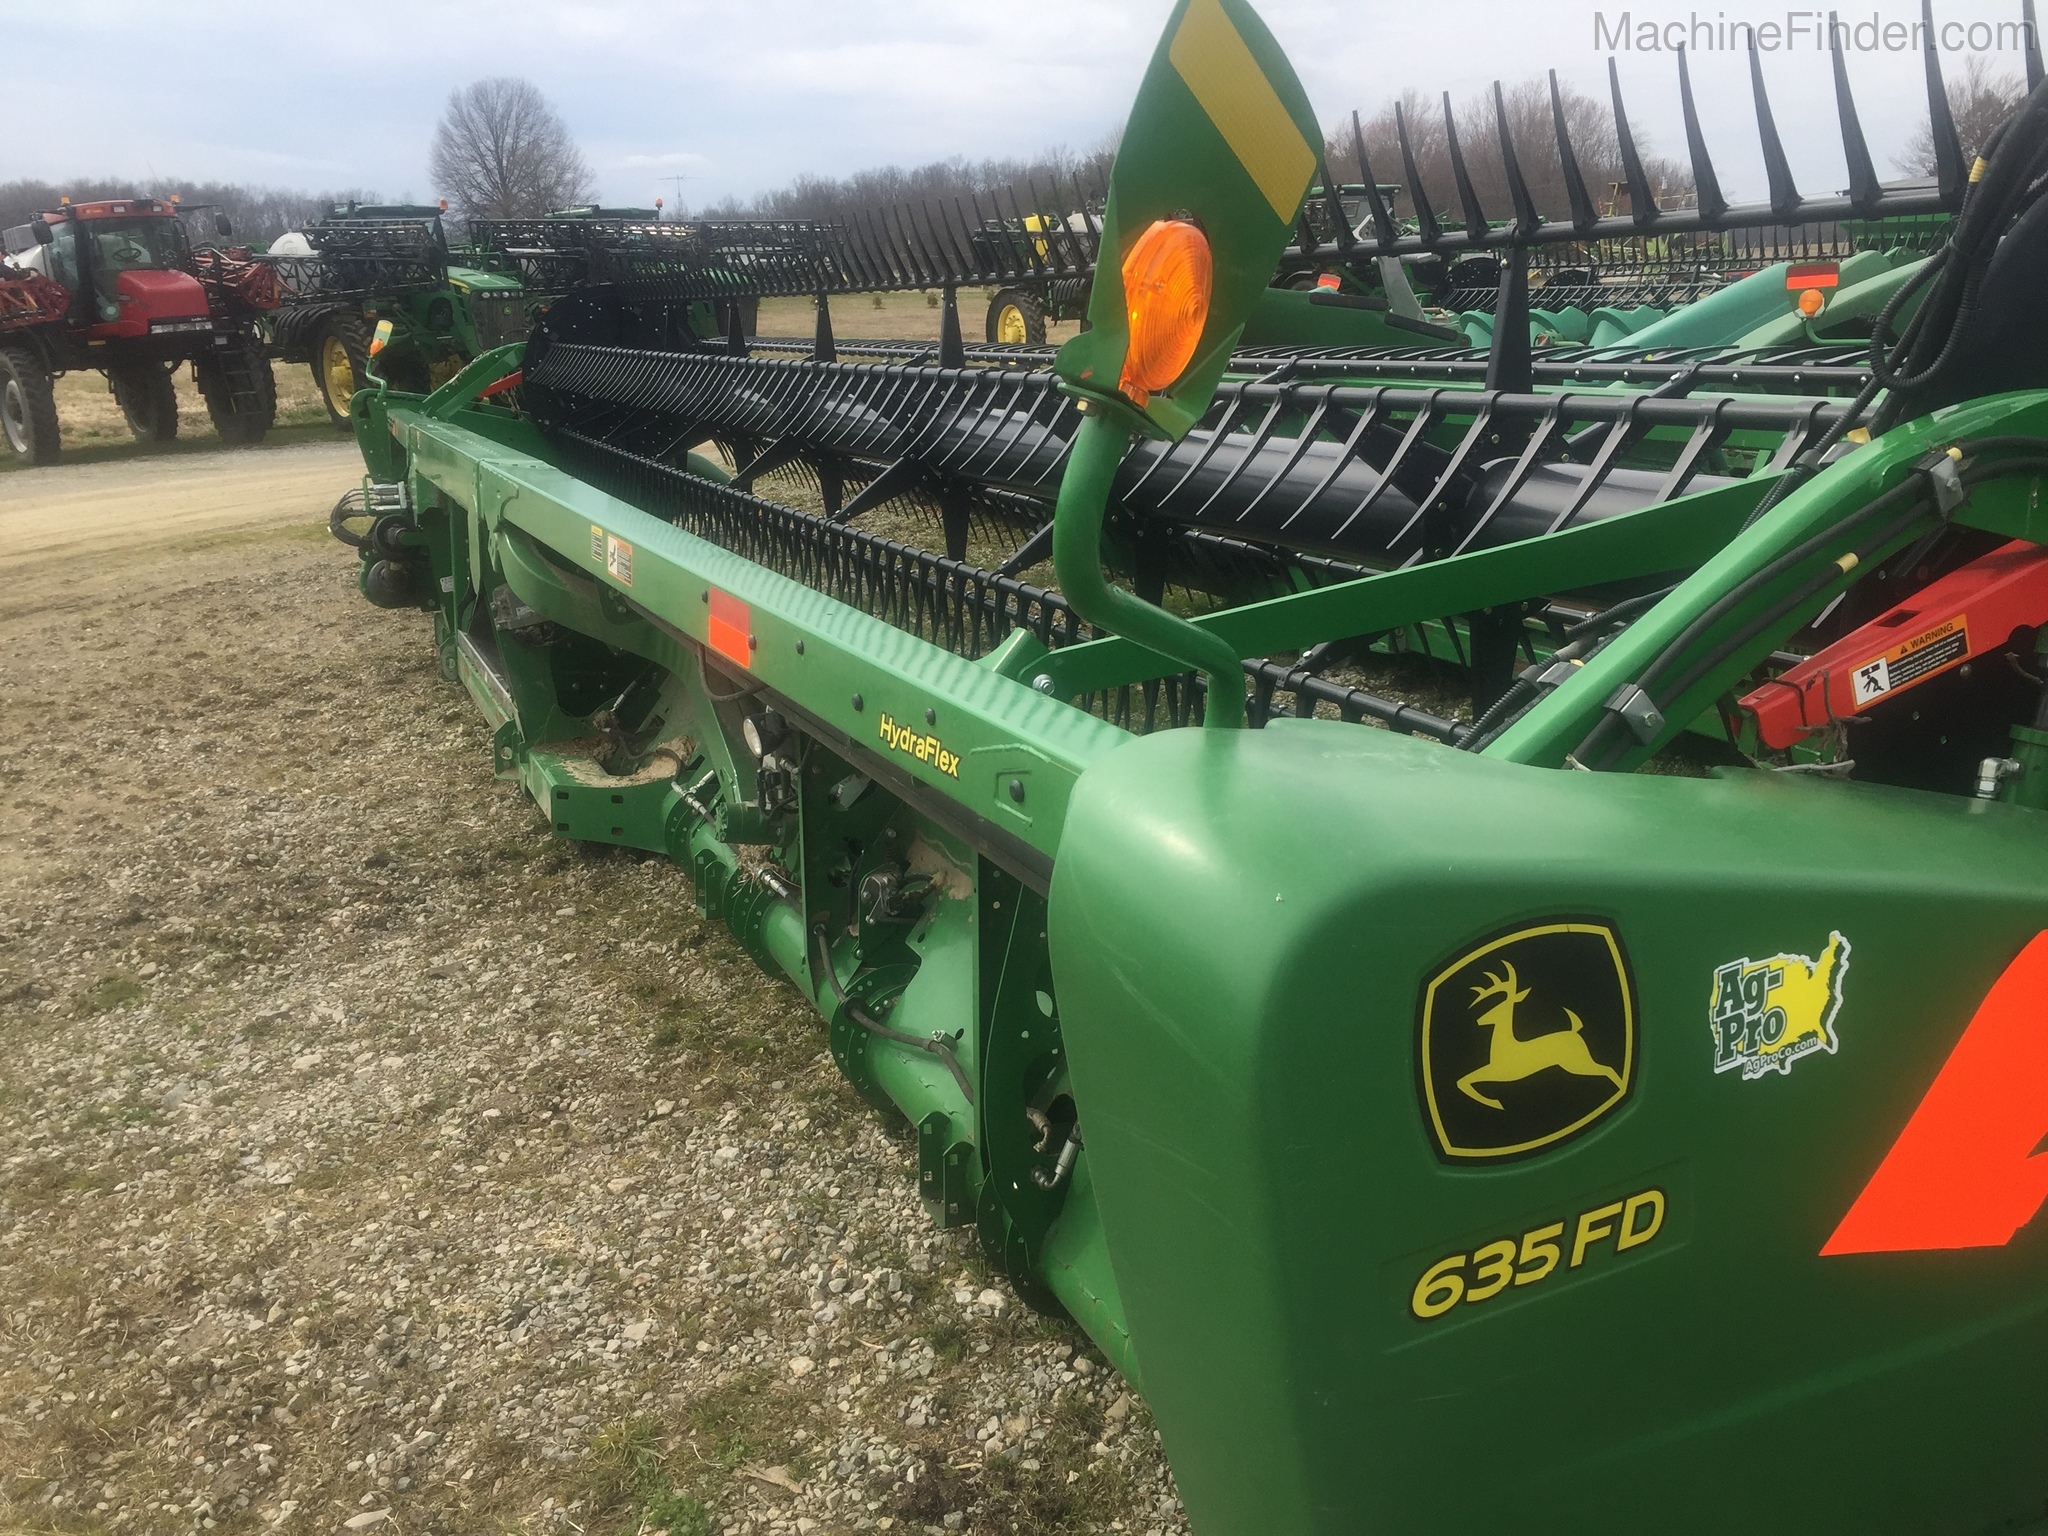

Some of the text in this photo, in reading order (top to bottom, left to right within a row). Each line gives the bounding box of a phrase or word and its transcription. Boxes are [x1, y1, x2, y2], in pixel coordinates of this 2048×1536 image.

[1910, 622, 1954, 649] WARNING
[879, 712, 960, 778] HydraFlex
[1713, 963, 1784, 1021] Ag-
[1715, 1006, 1788, 1067] Pro
[1744, 1036, 1819, 1075] AgProCo.com
[1411, 1189, 1666, 1319] 635FD
